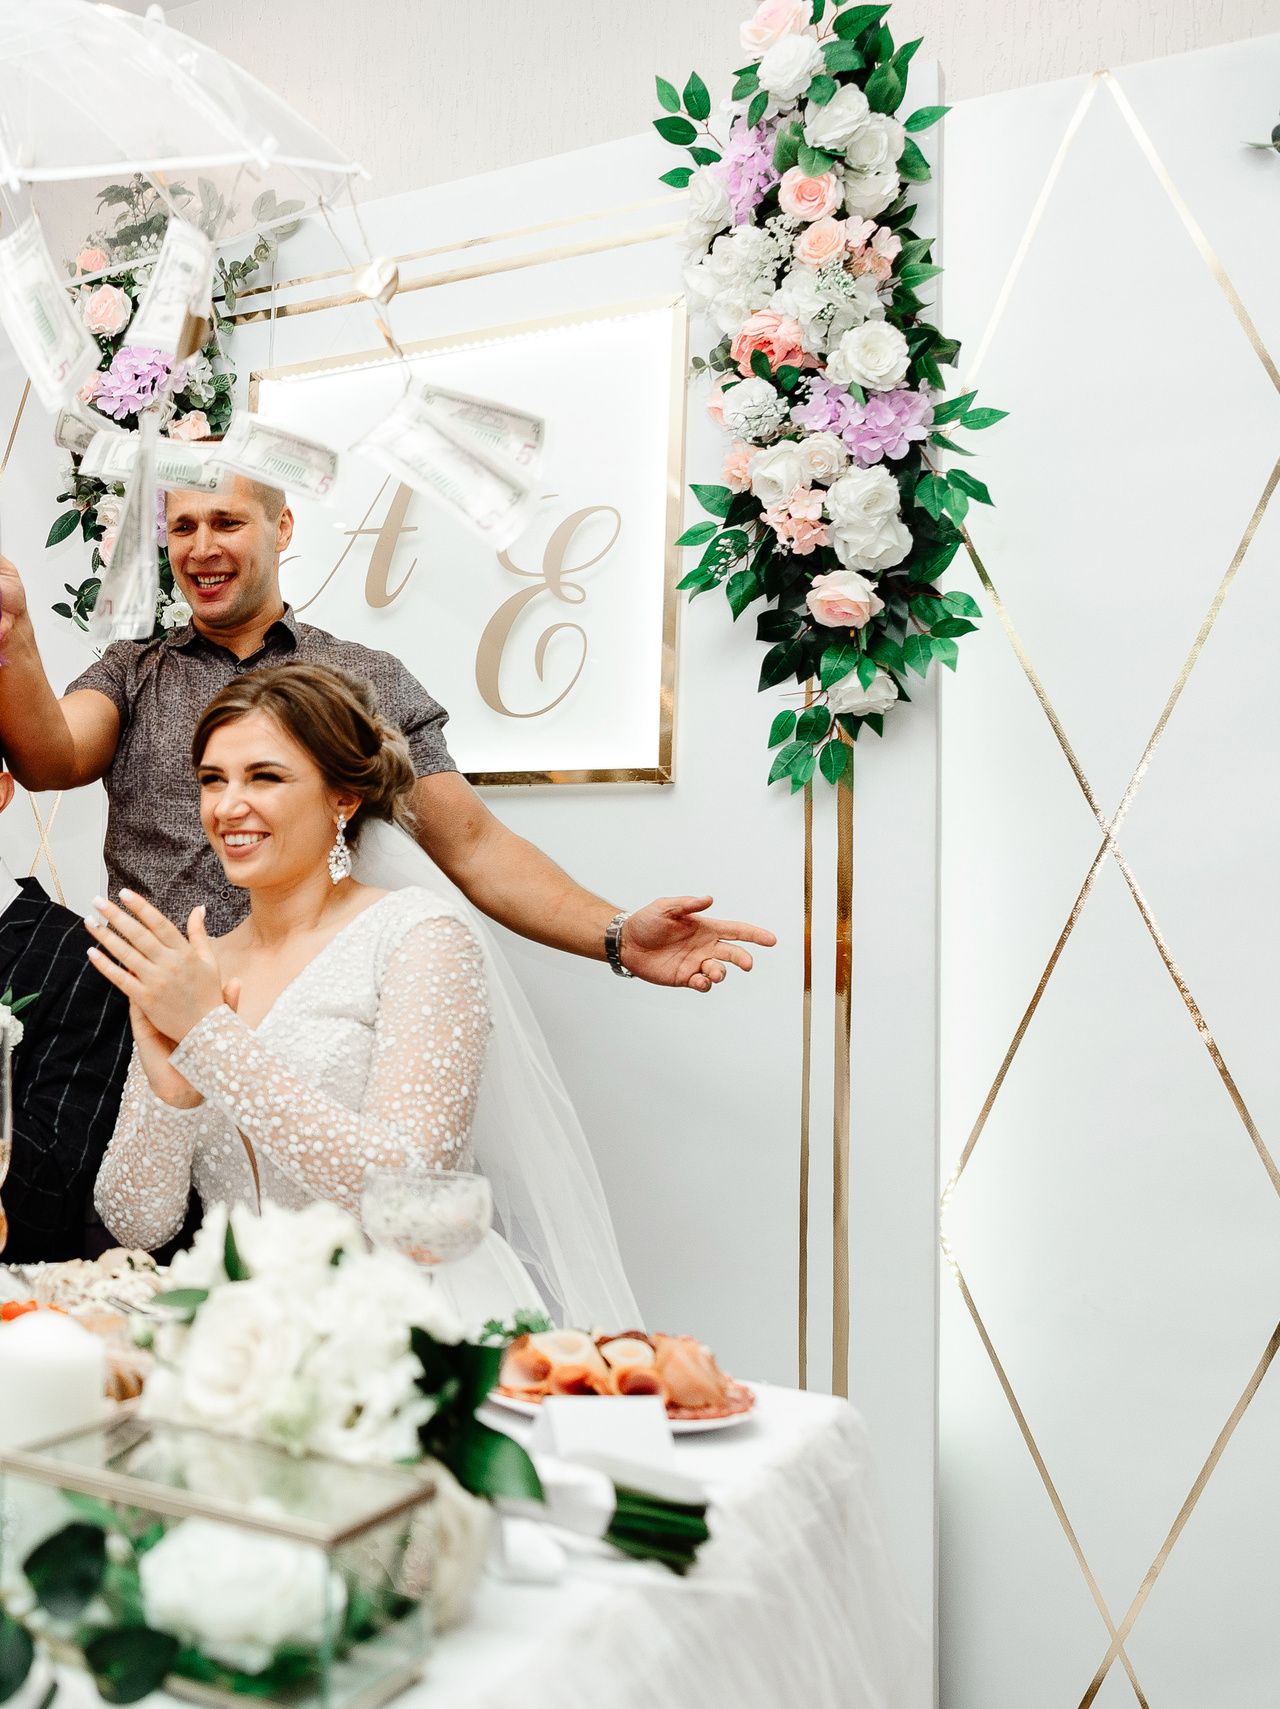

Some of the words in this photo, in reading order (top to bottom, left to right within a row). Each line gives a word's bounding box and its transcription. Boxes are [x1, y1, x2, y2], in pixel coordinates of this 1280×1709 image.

[515, 443, 537, 466] 5
[208, 477, 218, 489] 5
[314, 474, 334, 496] 5
[278, 474, 419, 609] A
[475, 498, 622, 719] E
